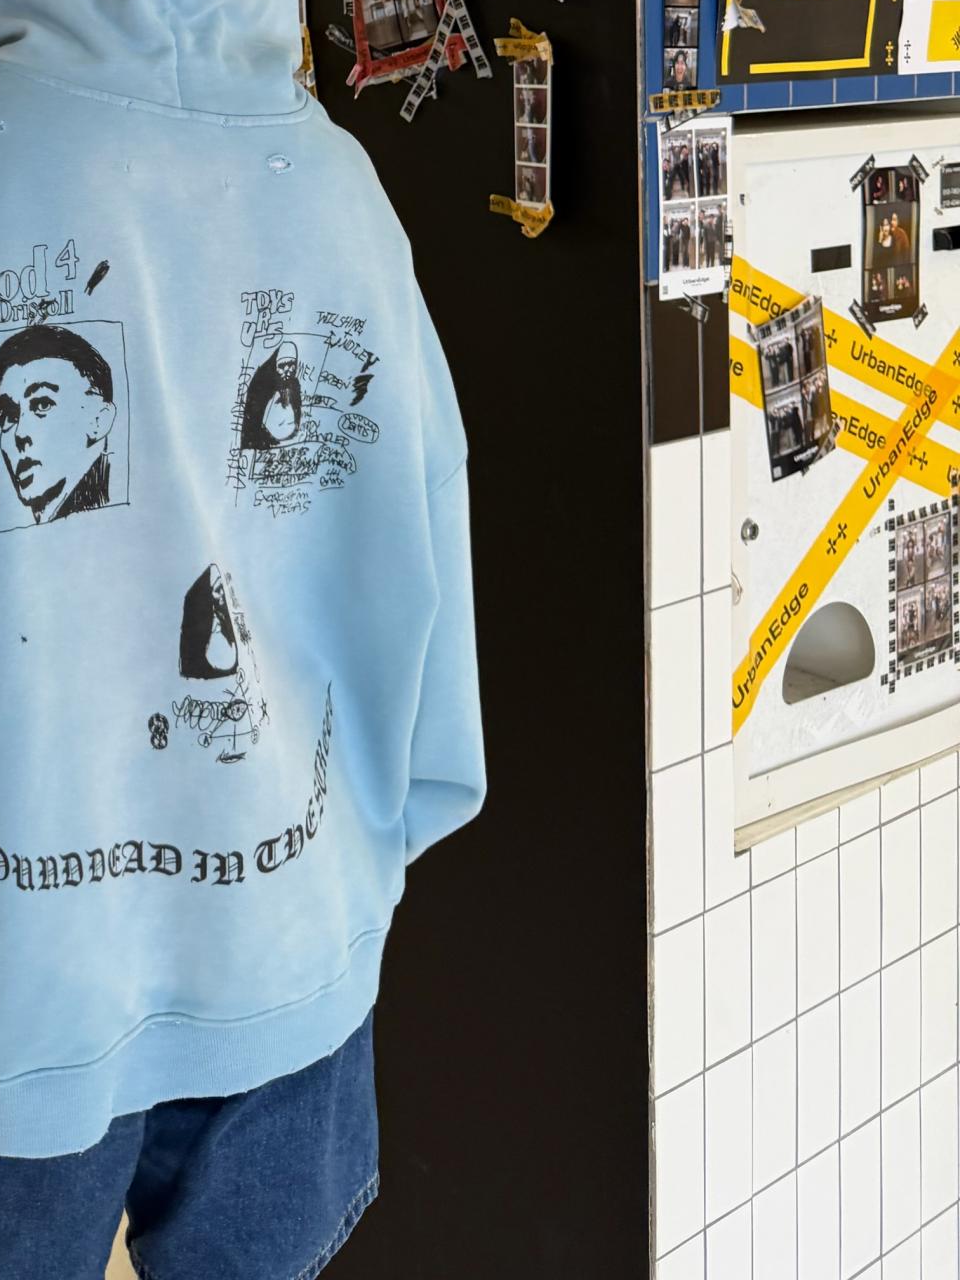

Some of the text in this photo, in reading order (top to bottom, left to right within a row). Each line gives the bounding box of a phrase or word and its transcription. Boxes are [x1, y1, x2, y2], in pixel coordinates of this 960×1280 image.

[851, 341, 932, 396] UrbanEdge
[863, 390, 937, 499] UrbanEdge
[732, 583, 809, 709] UrbanEdge
[192, 849, 246, 885] IN
